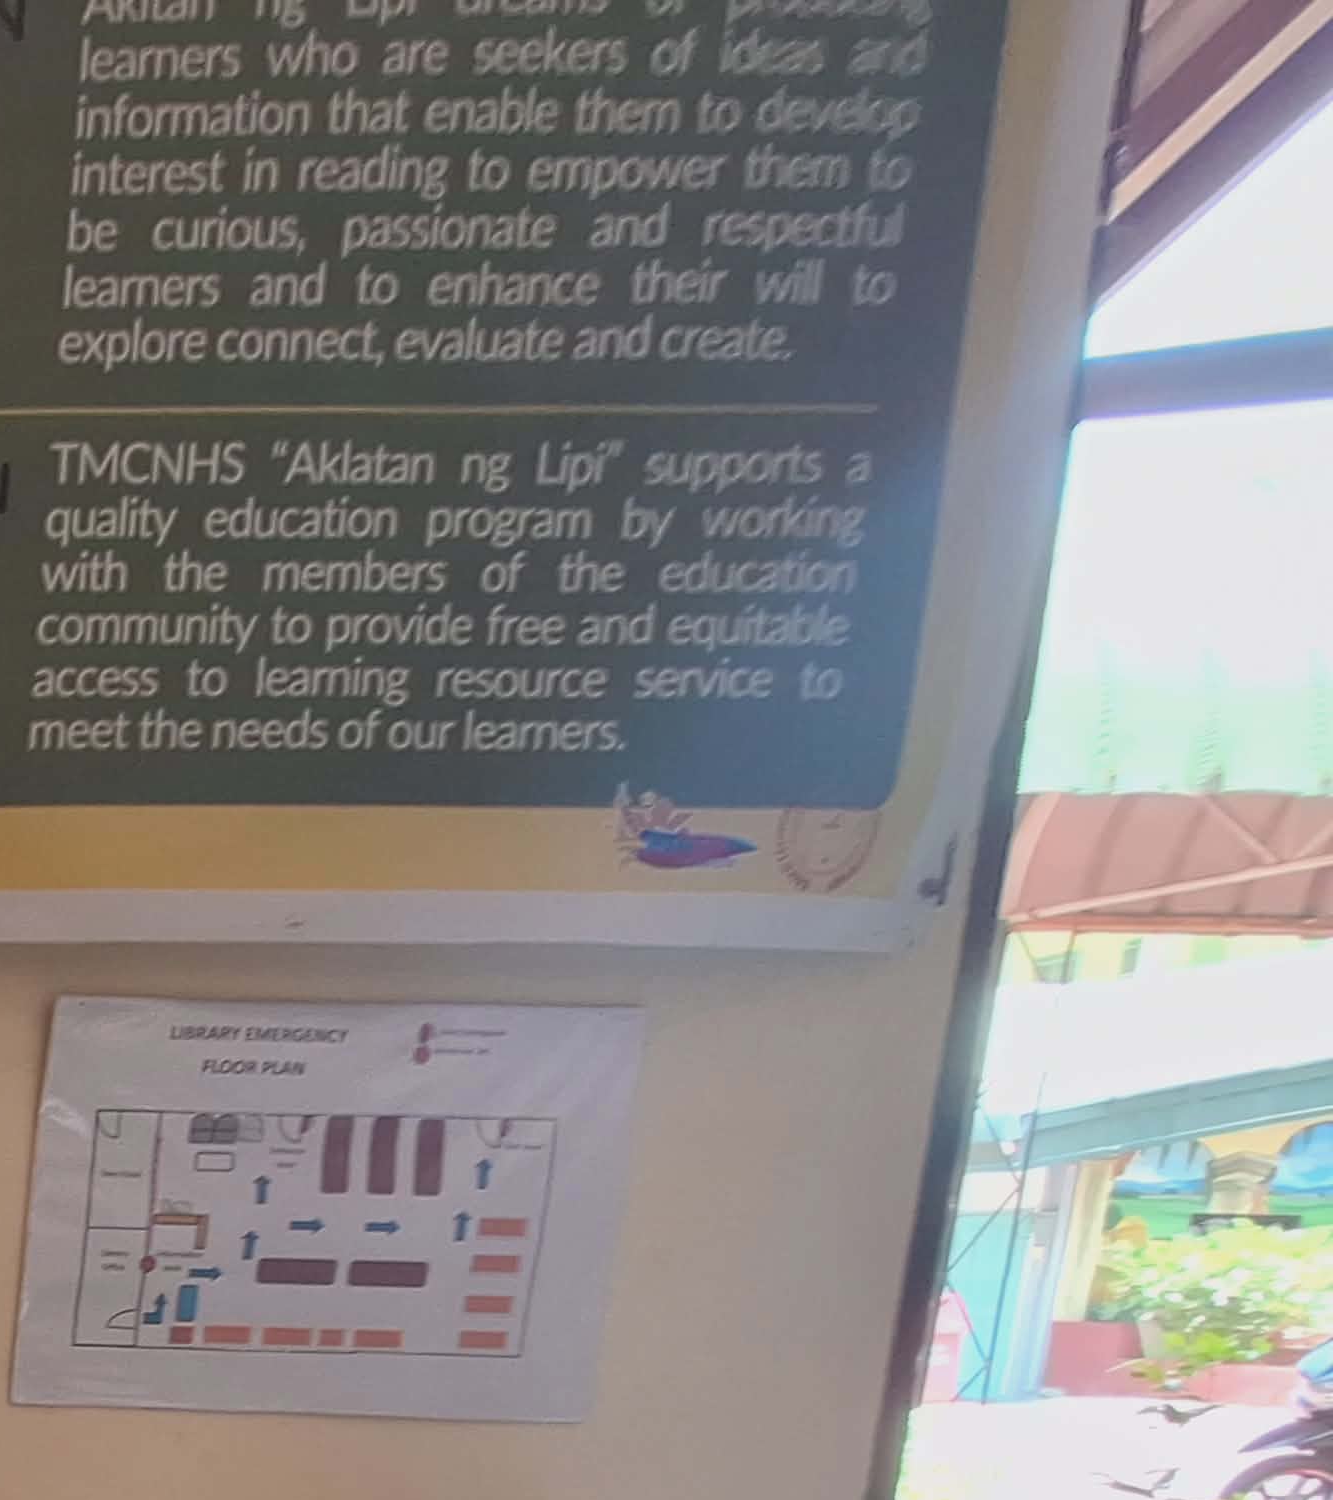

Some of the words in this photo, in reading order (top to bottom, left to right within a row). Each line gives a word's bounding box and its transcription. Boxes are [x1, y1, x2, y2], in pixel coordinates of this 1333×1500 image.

[80, 38, 241, 82] learners
[268, 33, 356, 75] who
[382, 39, 448, 75] are
[472, 27, 628, 75] seekers
[652, 27, 697, 75] of
[720, 30, 823, 75] ideas
[848, 30, 926, 75] and
[75, 90, 309, 139] information
[328, 88, 408, 134] that
[423, 87, 558, 134] enable
[575, 90, 681, 135] them
[698, 95, 741, 134] to
[756, 86, 922, 143] develop
[71, 146, 222, 196] interest
[242, 145, 280, 193] in
[298, 144, 448, 199] reading
[467, 153, 511, 192] to
[527, 156, 727, 200] empower
[743, 149, 851, 192] them
[869, 150, 911, 192] to
[66, 208, 119, 253] be
[152, 206, 306, 255] curious,
[341, 203, 557, 257] passionate
[590, 203, 669, 247] and
[702, 203, 905, 252] respectful
[63, 264, 220, 308] learners
[250, 262, 326, 306] and
[356, 268, 400, 305] to
[427, 262, 601, 306] enhance
[632, 259, 727, 302] their
[755, 258, 824, 304] will
[854, 268, 896, 304] to
[58, 318, 204, 372] explore
[217, 323, 384, 368] connect,
[394, 317, 563, 361] evaluate
[573, 317, 651, 360] and
[659, 322, 795, 361] create.
[50, 441, 245, 485] TMCNHS
[271, 440, 433, 484] “Aklatan
[460, 446, 512, 491] ng
[643, 444, 821, 490] supports
[844, 449, 873, 483] a
[45, 498, 177, 545] quality
[204, 497, 397, 538] education
[425, 504, 593, 546] program
[620, 497, 676, 546] by
[702, 497, 866, 547] working
[42, 549, 127, 592] with
[165, 550, 228, 592] the
[262, 550, 447, 592] members
[481, 550, 527, 592] of
[559, 552, 623, 592] the
[657, 550, 858, 594] education
[38, 605, 258, 652] community
[272, 610, 311, 644] to
[325, 605, 472, 652] provide
[486, 604, 571, 646] free
[576, 605, 654, 645] and
[668, 602, 850, 650] equitable
[33, 664, 158, 698] access
[187, 662, 229, 698] to
[255, 657, 409, 705] learning
[436, 661, 606, 700] resource
[635, 660, 773, 700] service
[800, 665, 843, 698] to
[28, 710, 130, 750] meet
[139, 710, 203, 749] the
[210, 709, 329, 750] needs
[337, 708, 383, 751] of
[388, 717, 453, 751] our
[463, 710, 628, 751] learners.
[170, 1026, 241, 1040] LIBRARY
[244, 1026, 349, 1043] EMERGENCY
[201, 1059, 259, 1075] FLOOR
[261, 1061, 306, 1075] PLAN
